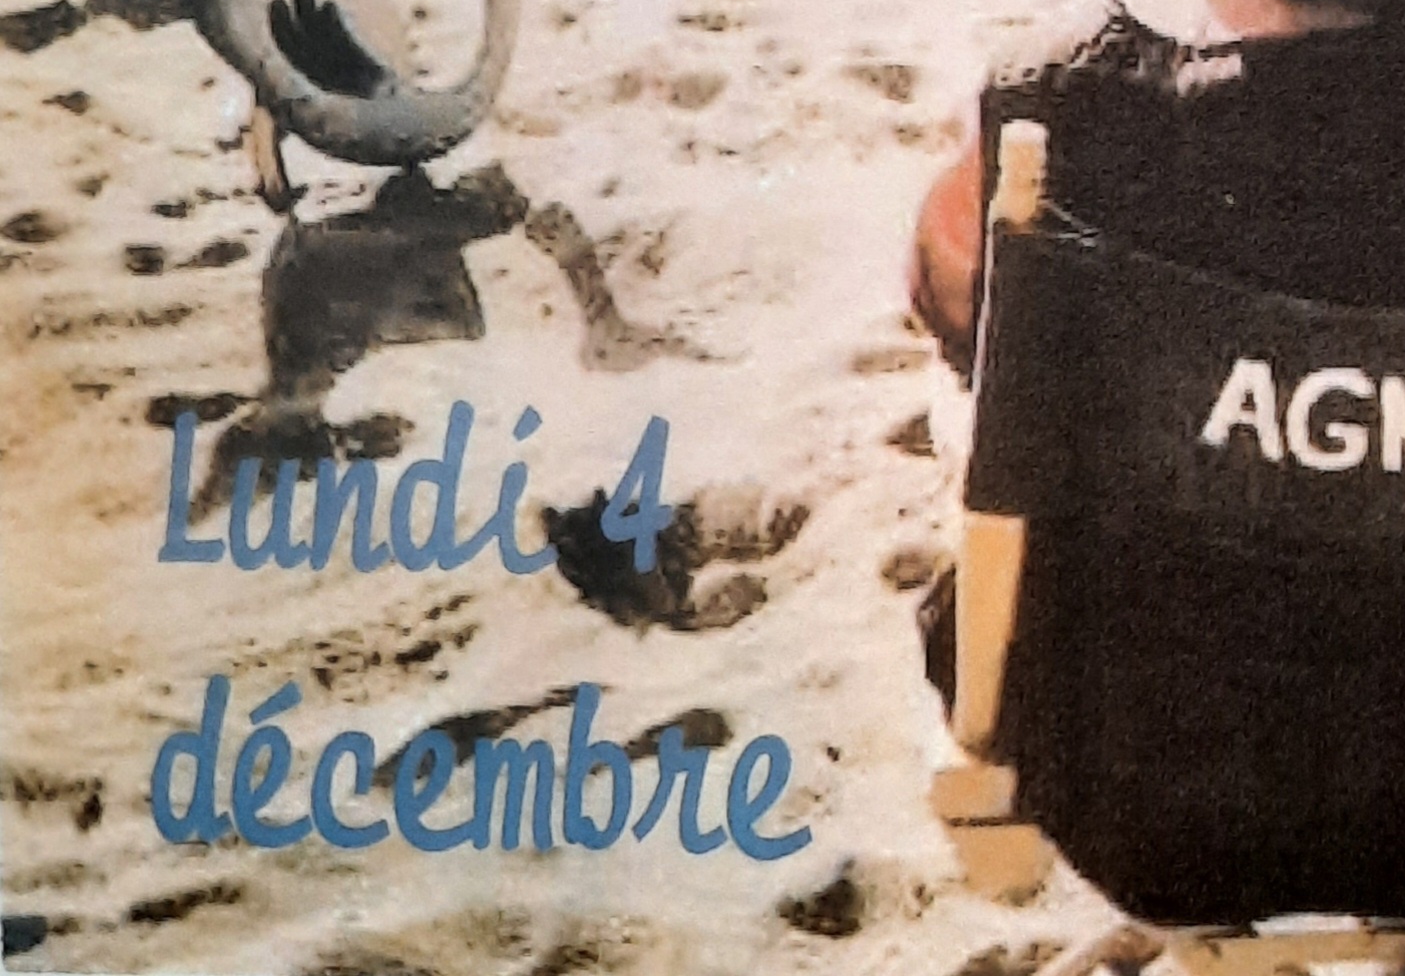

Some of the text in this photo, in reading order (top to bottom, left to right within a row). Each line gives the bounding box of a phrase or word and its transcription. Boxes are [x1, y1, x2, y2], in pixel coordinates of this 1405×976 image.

[158, 399, 673, 575] Lundi 4
[150, 673, 813, 861] décembre
